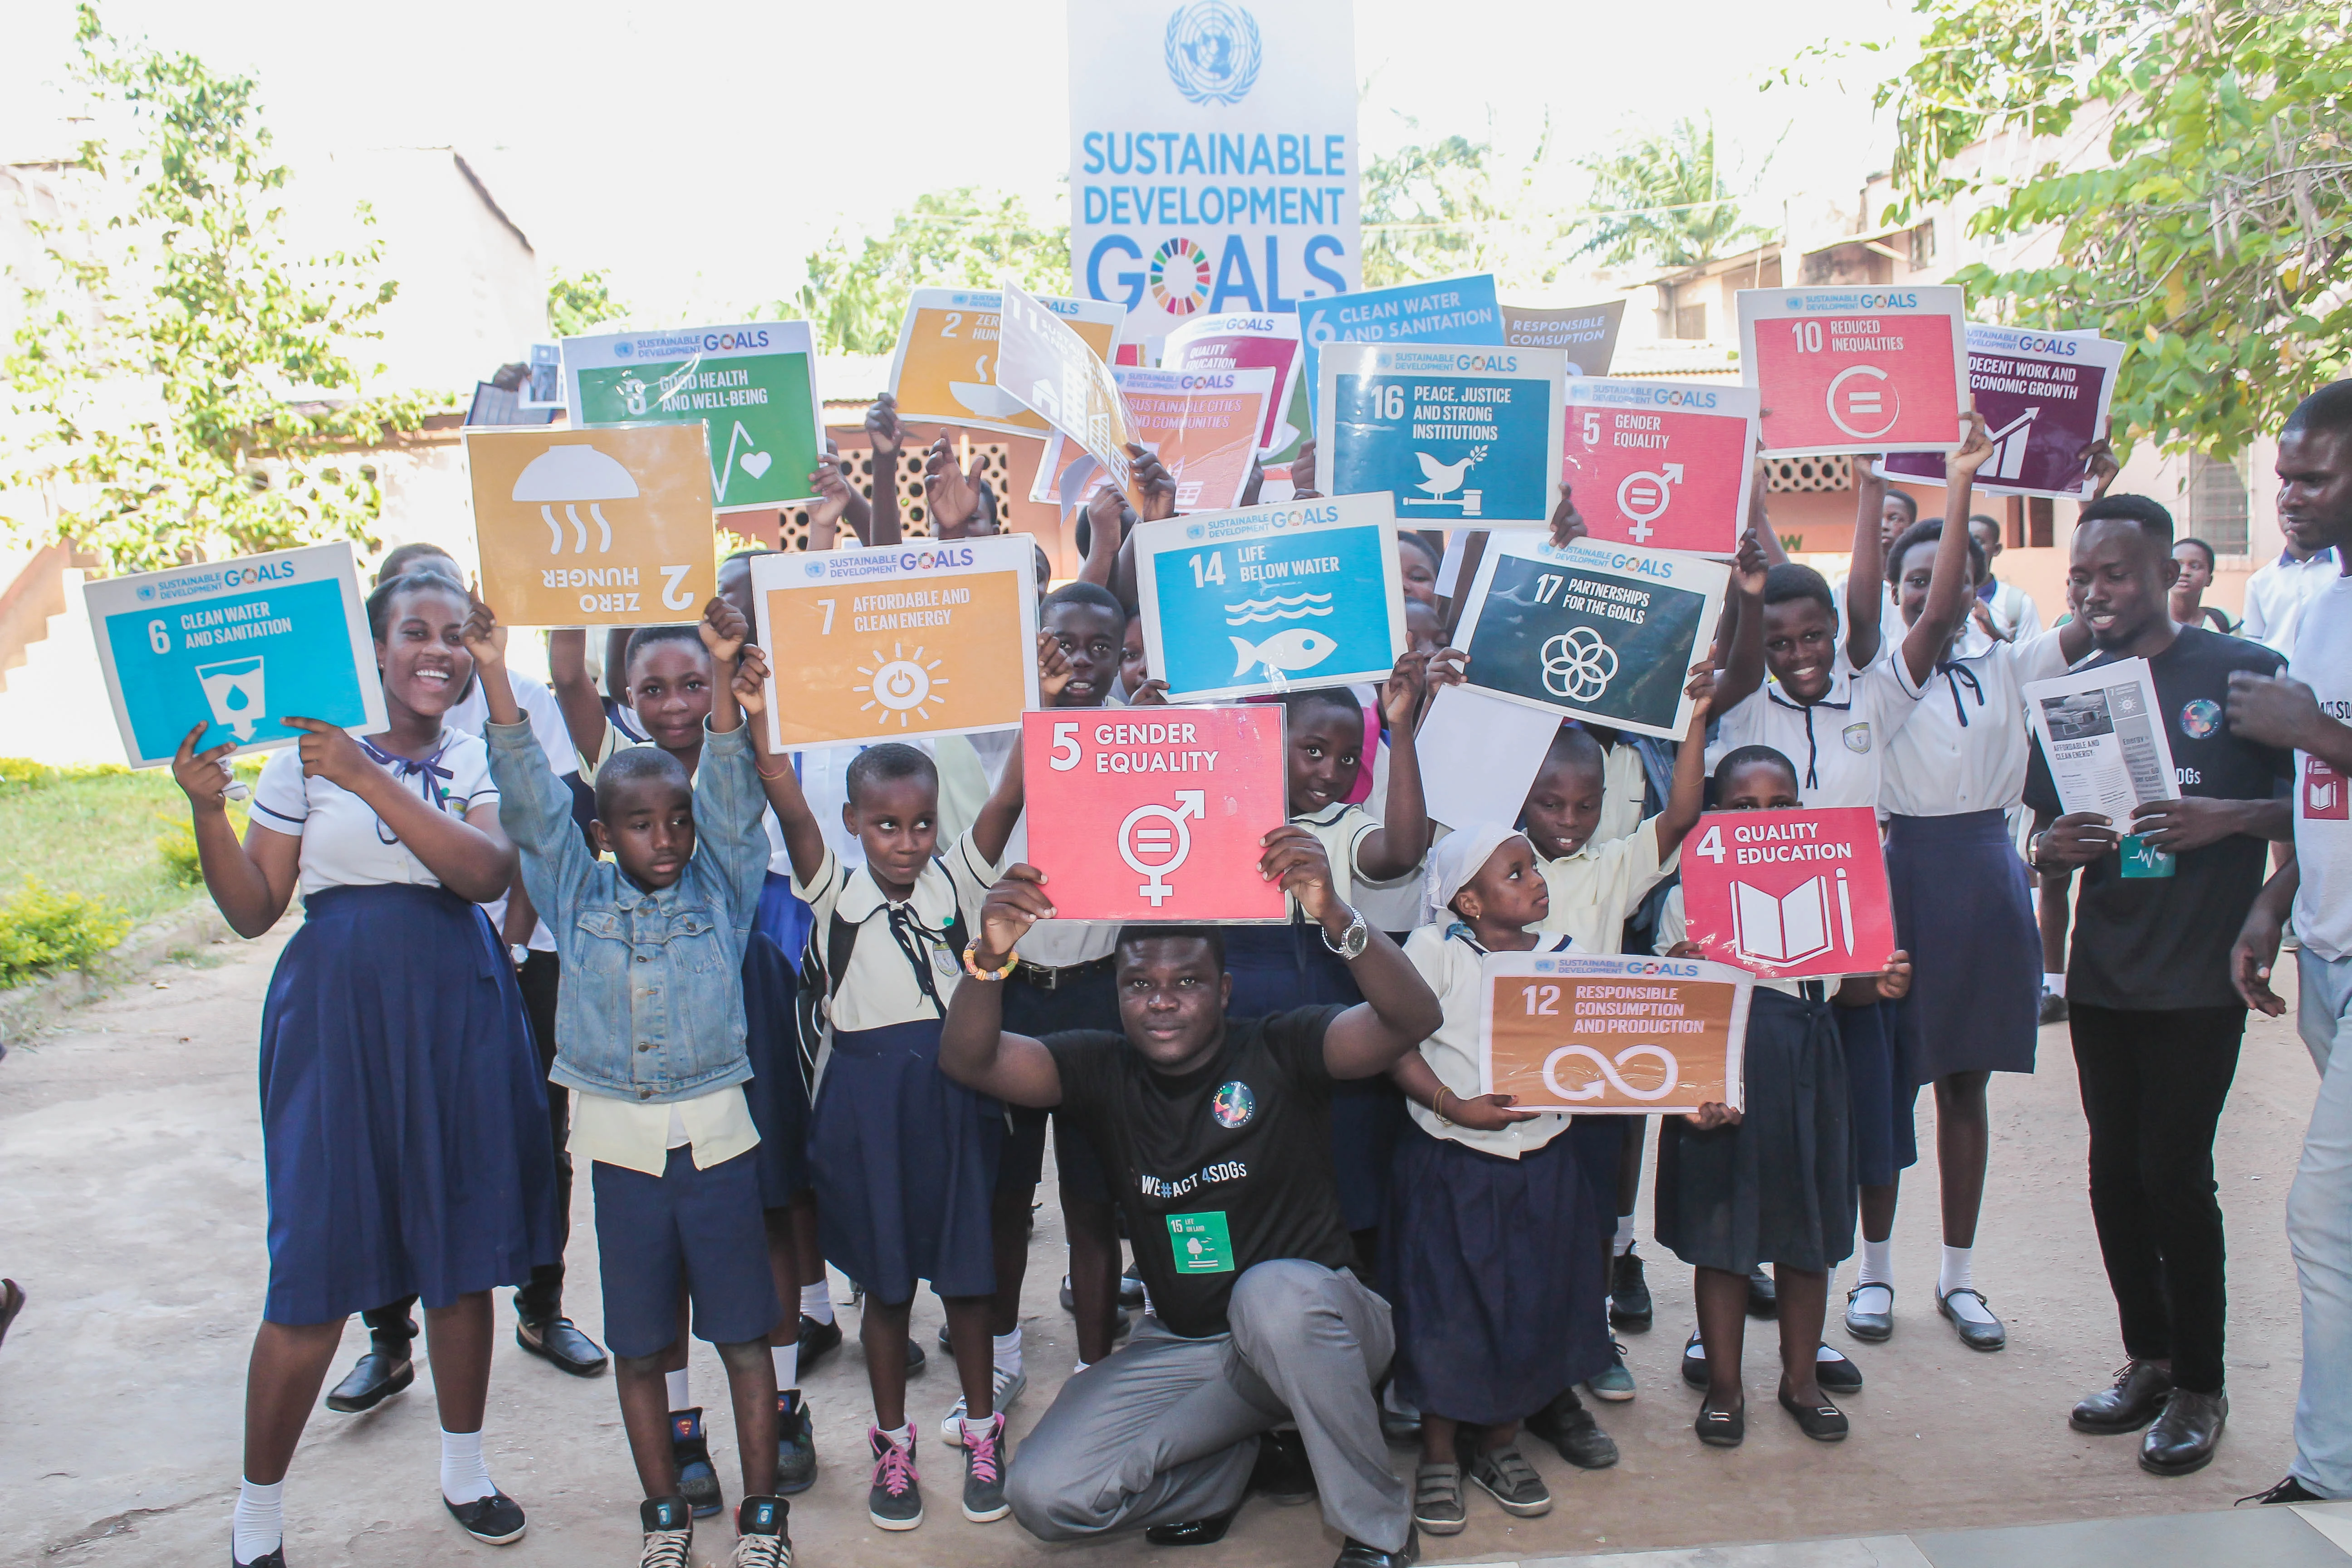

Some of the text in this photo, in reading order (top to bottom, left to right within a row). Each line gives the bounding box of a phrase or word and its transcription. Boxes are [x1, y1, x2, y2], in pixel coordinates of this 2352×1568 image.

[1083, 131, 1345, 176] SUSTAINABLE
[1084, 185, 1345, 225] DEVELOPMENT
[1086, 233, 1348, 316] GOALS
[1339, 291, 1460, 323] CLEAN WATER
[1806, 294, 1858, 304] SUSTAINABLE
[1806, 301, 1859, 311] DEVELOPMENT
[1861, 293, 1917, 309] GOALS
[976, 314, 999, 327] ZER
[1010, 294, 1037, 333] 11
[941, 312, 963, 338] 2
[1226, 318, 1274, 331] GOALS
[1307, 309, 1336, 348] 6
[1343, 307, 1492, 342] AND SANITATION
[1512, 316, 1605, 332] RESPONSIBLE
[1830, 320, 1880, 334] REDUCED
[637, 334, 701, 348] SUSTAINABLE
[703, 330, 769, 351] GOALS
[972, 328, 999, 341] HUN
[1509, 329, 1605, 345] COMSUPTION
[1792, 320, 1823, 353] 10
[1967, 329, 2019, 341] USTAINABLE
[1967, 338, 2017, 350] EVELOPMENT
[638, 345, 701, 358] DEVELOPMENT
[1190, 343, 1228, 359] QUALITY
[1831, 336, 1905, 353] INEQUALITIES
[2019, 335, 2077, 356] GOALS
[1395, 363, 1454, 371] DEVELOPMENT
[1396, 353, 1455, 362] SUSTAINABLE
[1457, 354, 1518, 372] GOALS
[1128, 372, 1180, 382] SUSTAINABLE
[1969, 356, 2077, 382] DECENT WORK AND
[660, 369, 749, 392] GOOD HEALTH
[1181, 374, 1235, 389] GOALS
[1593, 384, 1652, 396] SUSTAINABLE
[661, 387, 769, 412] AND WELL-BEING
[1414, 385, 1512, 404] PEACE, JUSTICE
[1592, 393, 1651, 404] DEVELOPMENT
[1654, 387, 1717, 408] GOALS
[2028, 381, 2079, 400] GROWTH
[1128, 398, 1243, 413] SUSTAINABLE CITIES
[1371, 384, 1405, 421] 16
[1134, 414, 1231, 429] ND COMMUNITIES
[1413, 405, 1493, 422] AND STRONG
[1615, 413, 1662, 431] GENDER
[1412, 424, 1499, 441] INSTITUTIONS
[1583, 412, 1601, 445] 5
[1613, 431, 1670, 450] EQUALITY
[1208, 513, 1269, 529] SUSTAINABLE
[1271, 505, 1338, 529] GOALS
[1209, 523, 1269, 539] DEVELOPMENT
[829, 554, 897, 568] SUSTAINABLE
[900, 548, 974, 571] GOALS
[1237, 545, 1267, 564] LIFE
[1555, 553, 1610, 568] DEVELOPMENT
[224, 560, 295, 588] GOALS
[830, 564, 897, 578] DEVELOPMENT
[1188, 550, 1226, 588] 14
[1240, 556, 1341, 583] BELOW WATER
[1612, 553, 1673, 578] GOALS
[158, 572, 221, 591] SUSTAINABLE
[541, 567, 640, 588] HUNGER
[159, 583, 223, 599] DEVELOPMENT
[660, 564, 695, 611] 2
[1534, 573, 1564, 604] 17
[1567, 577, 1651, 608] PARTNERSHIPS
[578, 592, 641, 613] ZERO
[853, 587, 970, 613] AFFORDABLE AND
[1562, 593, 1646, 625] FOR THE GOALS
[181, 601, 270, 631] CLEAN WATER
[817, 598, 836, 635] 7
[854, 609, 952, 633] CLEAN ENERGY
[148, 619, 171, 655] 6
[186, 617, 293, 649] AND SANITATION
[2336, 701, 2352, 720] SD
[1094, 723, 1198, 745] GENDER
[1049, 721, 1083, 771] 5
[1095, 750, 1219, 774] EQUALITY
[2176, 767, 2201, 785] DGs
[1734, 822, 1818, 843] QUALITY
[1696, 825, 1727, 864] 4
[1736, 842, 1852, 865] EDUCATION
[1558, 959, 1624, 968] SUSTAINABLE
[1626, 962, 1699, 977] GOALS
[1521, 985, 1561, 1016] 12
[1576, 985, 1679, 1000] RESPONSIBLE
[1574, 1001, 1685, 1017] CONSUMPTION
[1573, 1018, 1705, 1034] AND PRODUCTION
[1142, 1161, 1247, 1198] WE#ACT 4SDGs
[1171, 1219, 1183, 1233] 15
